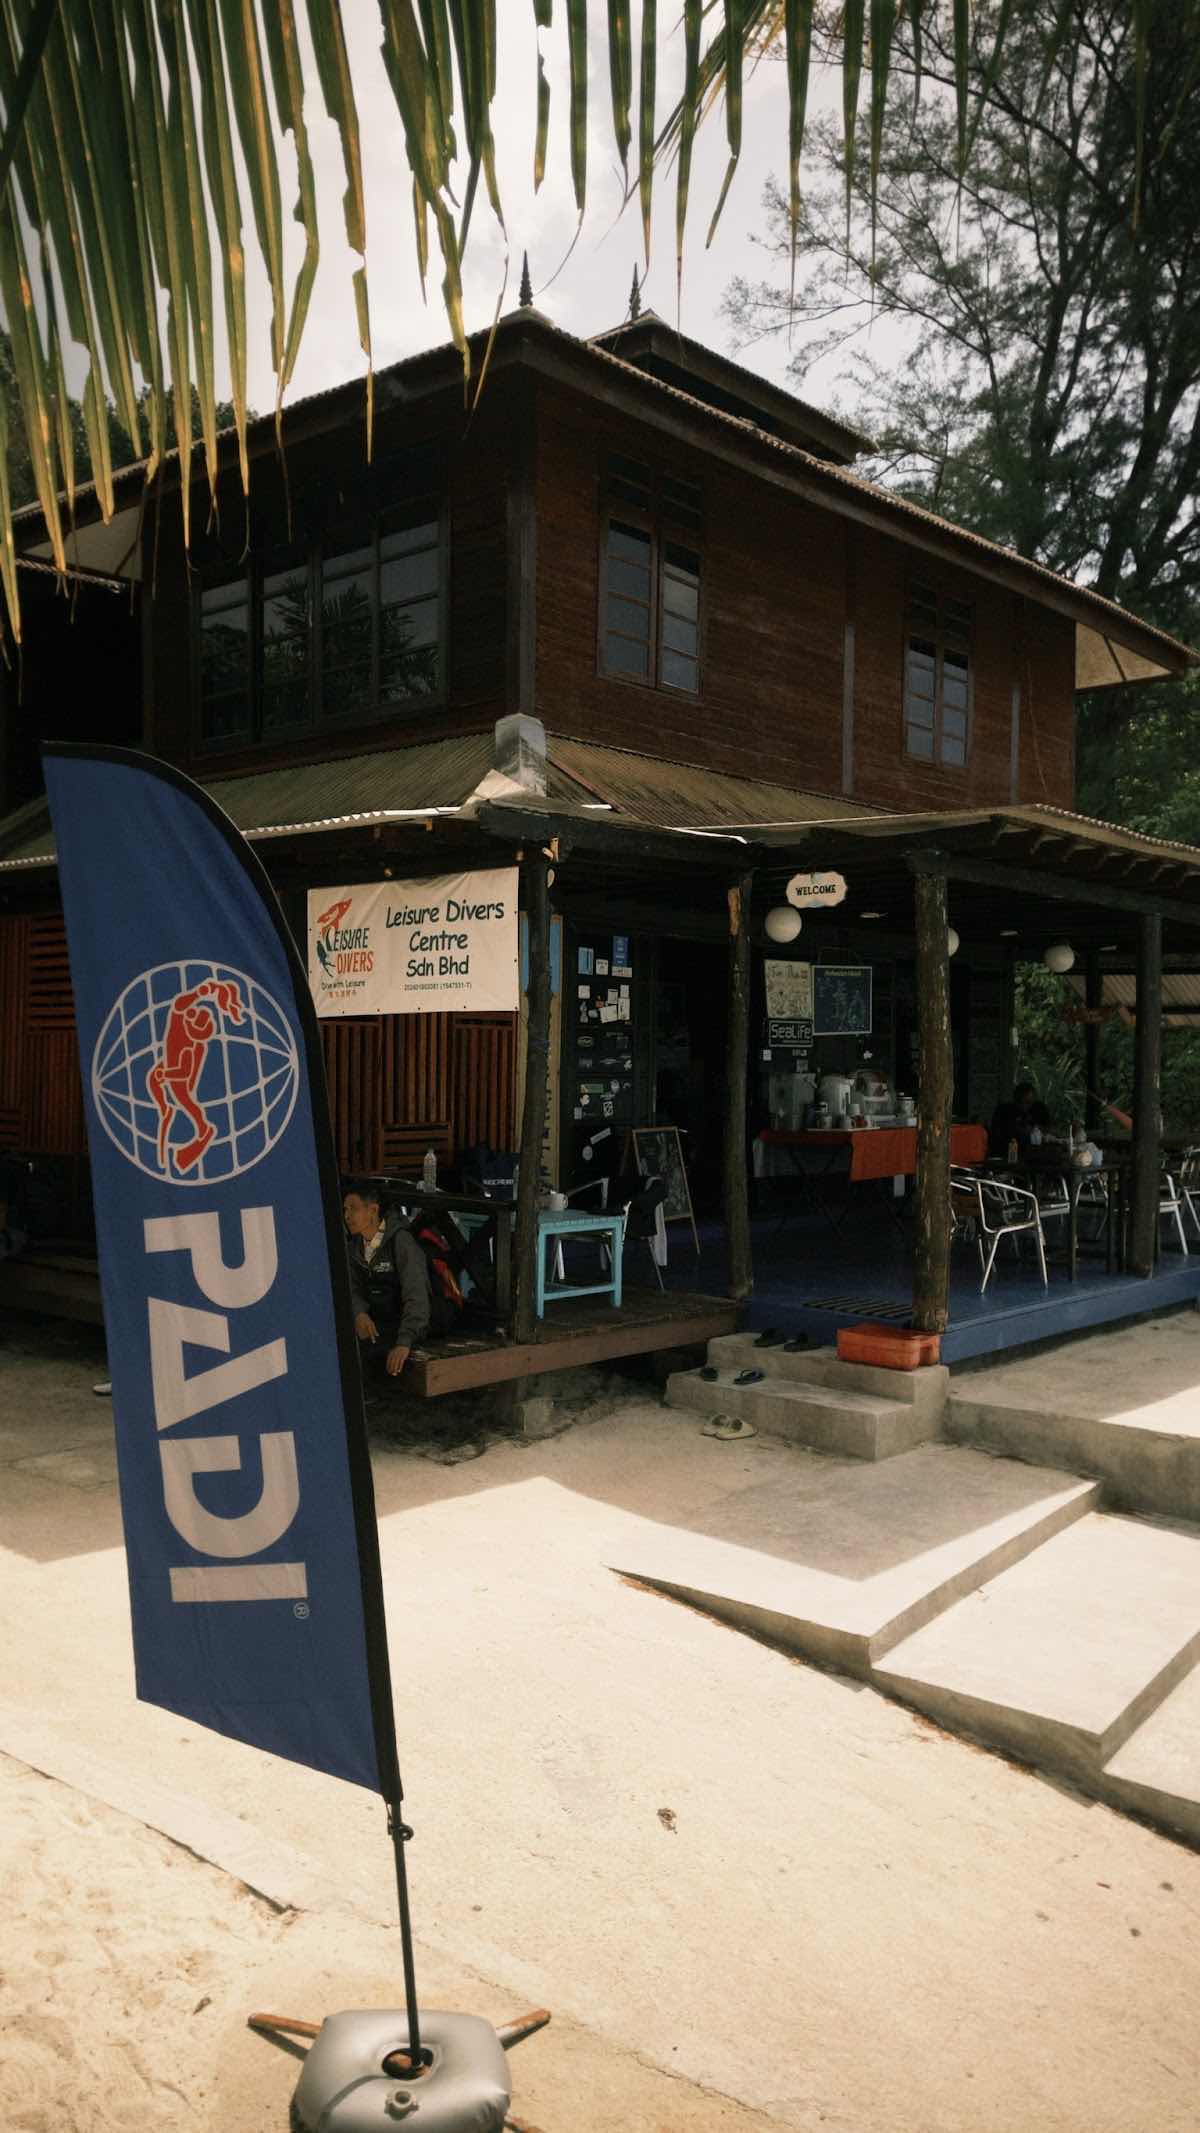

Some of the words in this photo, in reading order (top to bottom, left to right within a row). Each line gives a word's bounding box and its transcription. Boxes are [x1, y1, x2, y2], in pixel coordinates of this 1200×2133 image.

[795, 884, 837, 896] WELCOME
[385, 905, 440, 928] Leisure
[446, 899, 504, 922] Divers
[325, 927, 370, 952] LEISURE
[409, 930, 468, 952] Centre
[336, 951, 374, 974] DIVERS
[406, 957, 434, 977] Sdn
[439, 955, 470, 975] Bhd
[143, 1205, 309, 1602] PADI
